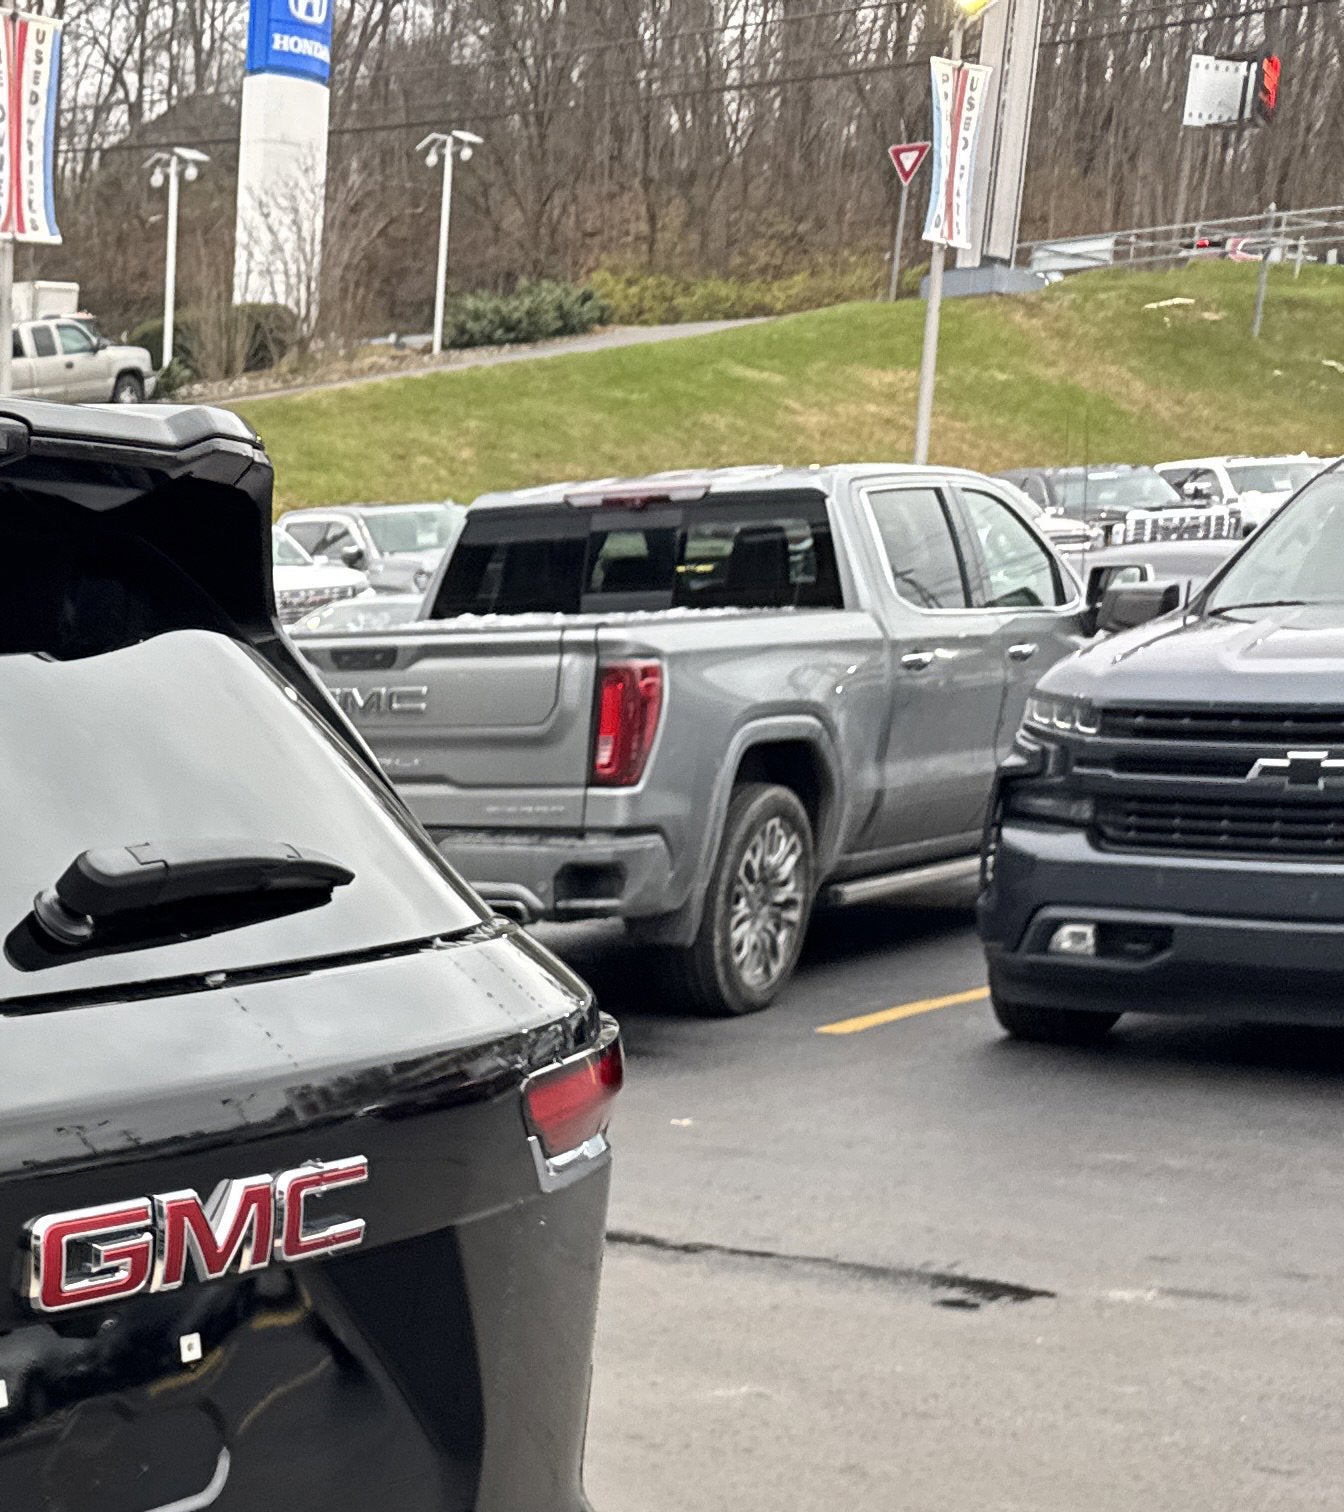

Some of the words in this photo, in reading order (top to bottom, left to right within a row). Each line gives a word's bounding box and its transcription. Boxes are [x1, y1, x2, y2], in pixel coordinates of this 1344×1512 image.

[28, 28, 47, 106] USED
[326, 683, 428, 713] MC
[24, 1155, 368, 1312] GMC
